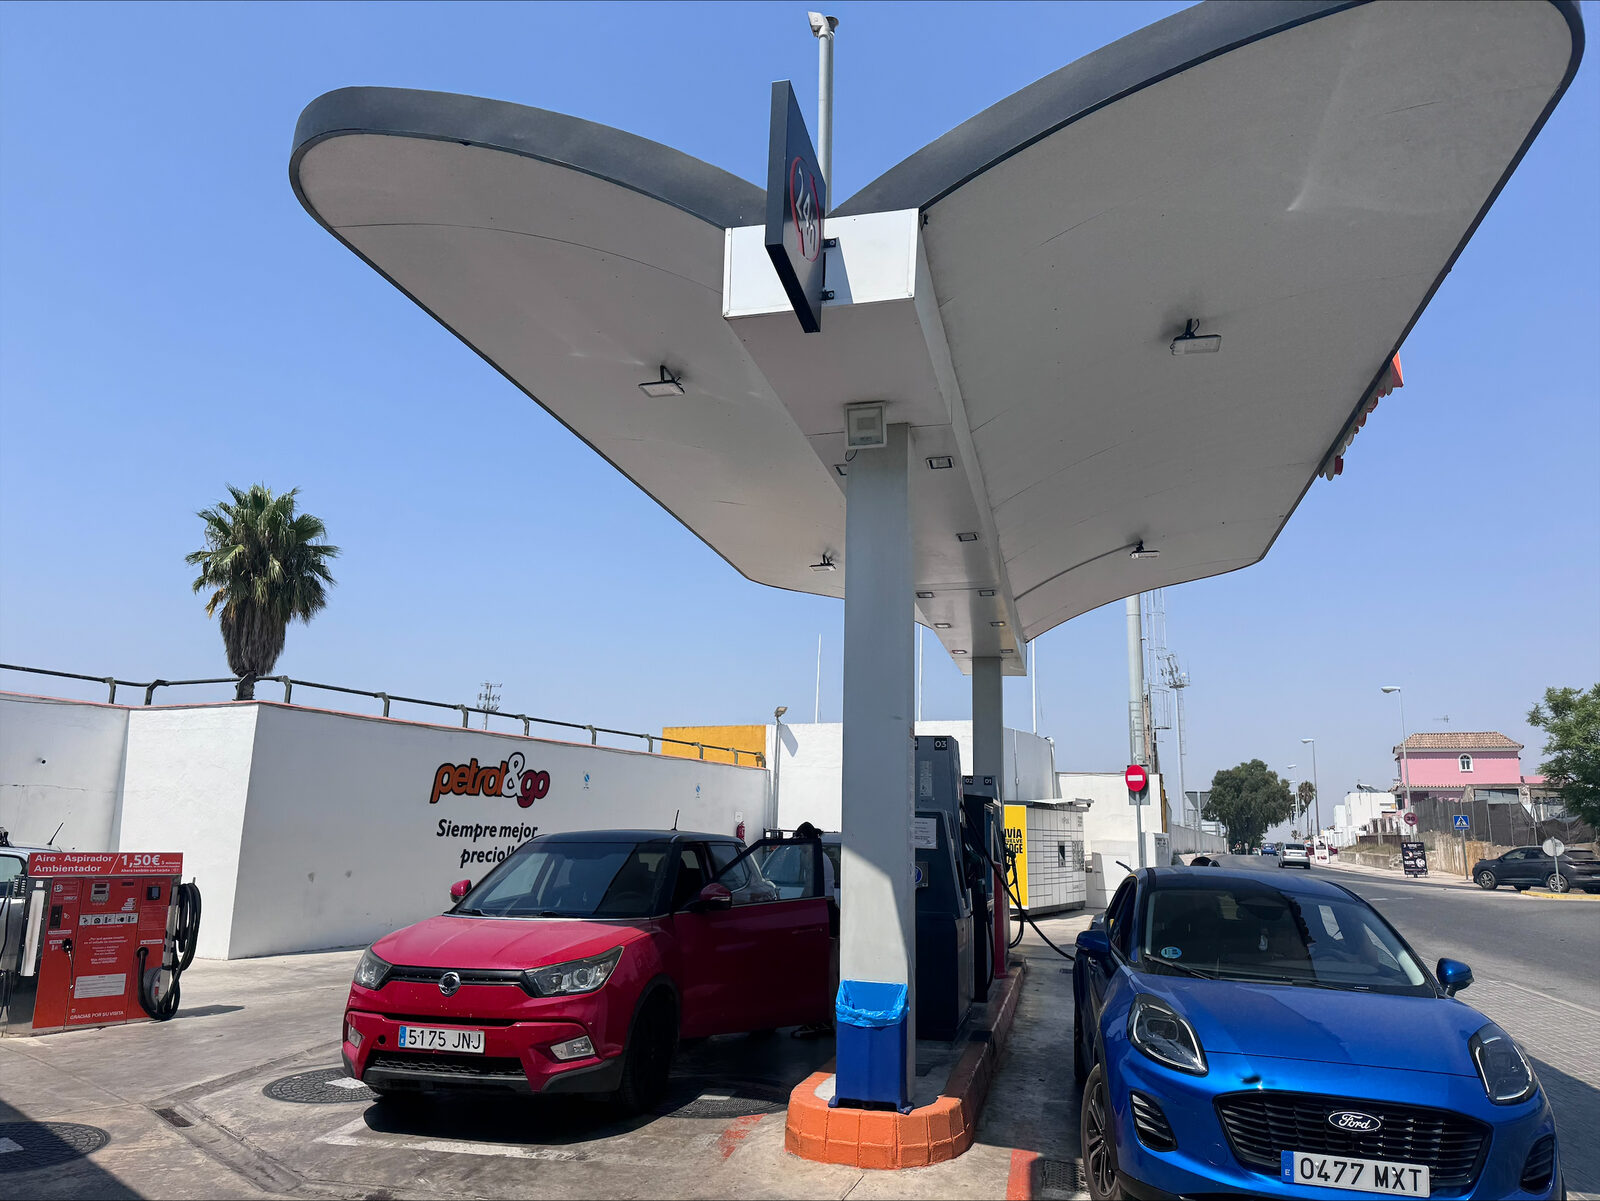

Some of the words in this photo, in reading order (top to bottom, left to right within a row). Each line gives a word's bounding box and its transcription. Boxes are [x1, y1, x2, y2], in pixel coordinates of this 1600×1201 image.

[429, 752, 551, 808] petrol&go
[436, 819, 497, 842] Siempre
[499, 822, 538, 842] mejor
[35, 854, 57, 862] Aire
[64, 854, 113, 864] Aspirador
[121, 854, 161, 868] 1,50€
[34, 864, 102, 873] Ambientador
[408, 1029, 447, 1047] 5175
[452, 1032, 481, 1049] JNJ
[1338, 1113, 1371, 1129] Ford
[1300, 1157, 1365, 1186] 0477
[1374, 1165, 1422, 1191] MXT
